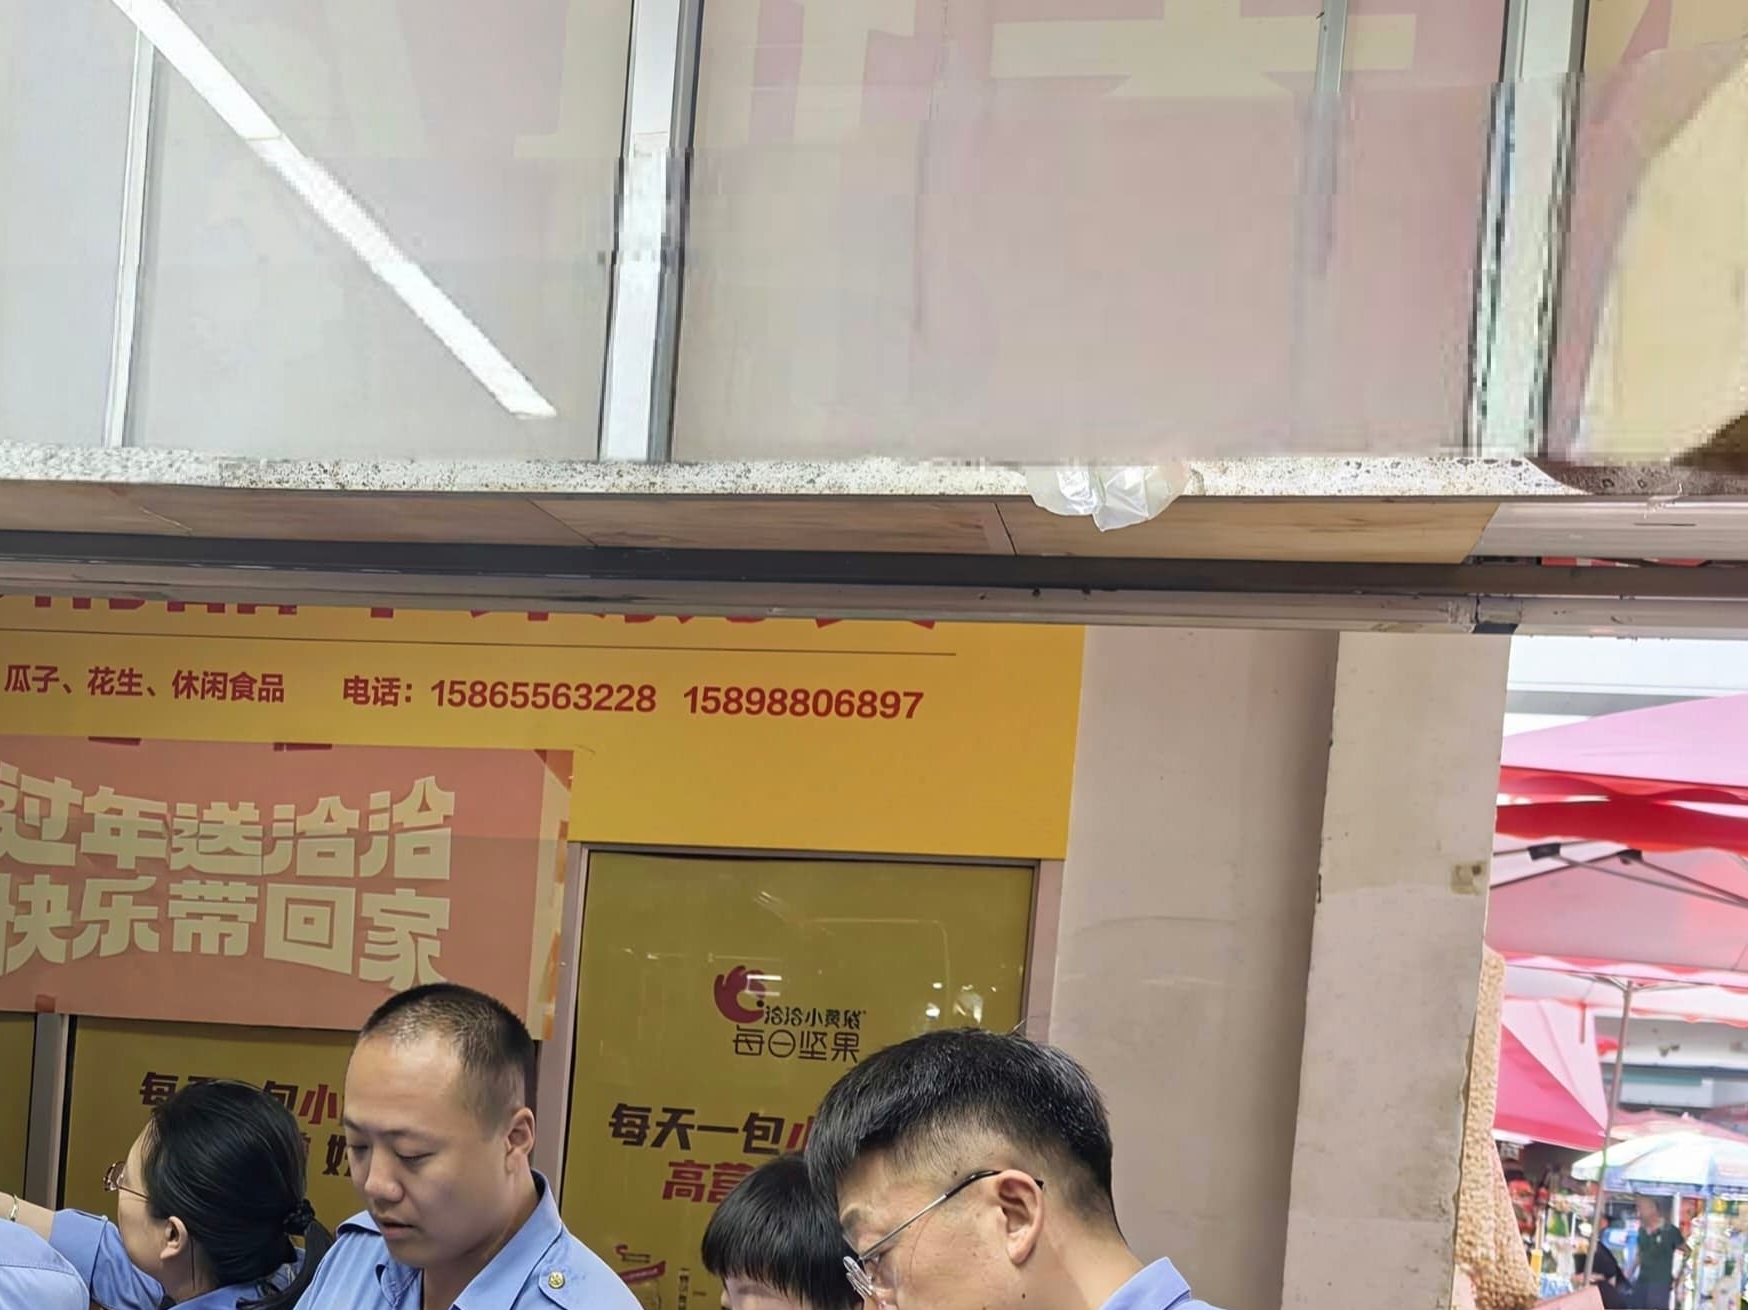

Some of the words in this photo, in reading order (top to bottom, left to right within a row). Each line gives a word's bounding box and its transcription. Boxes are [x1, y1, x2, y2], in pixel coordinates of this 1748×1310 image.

[683, 685, 924, 720] 15898806897
[733, 1025, 860, 1063] 每日坚果
